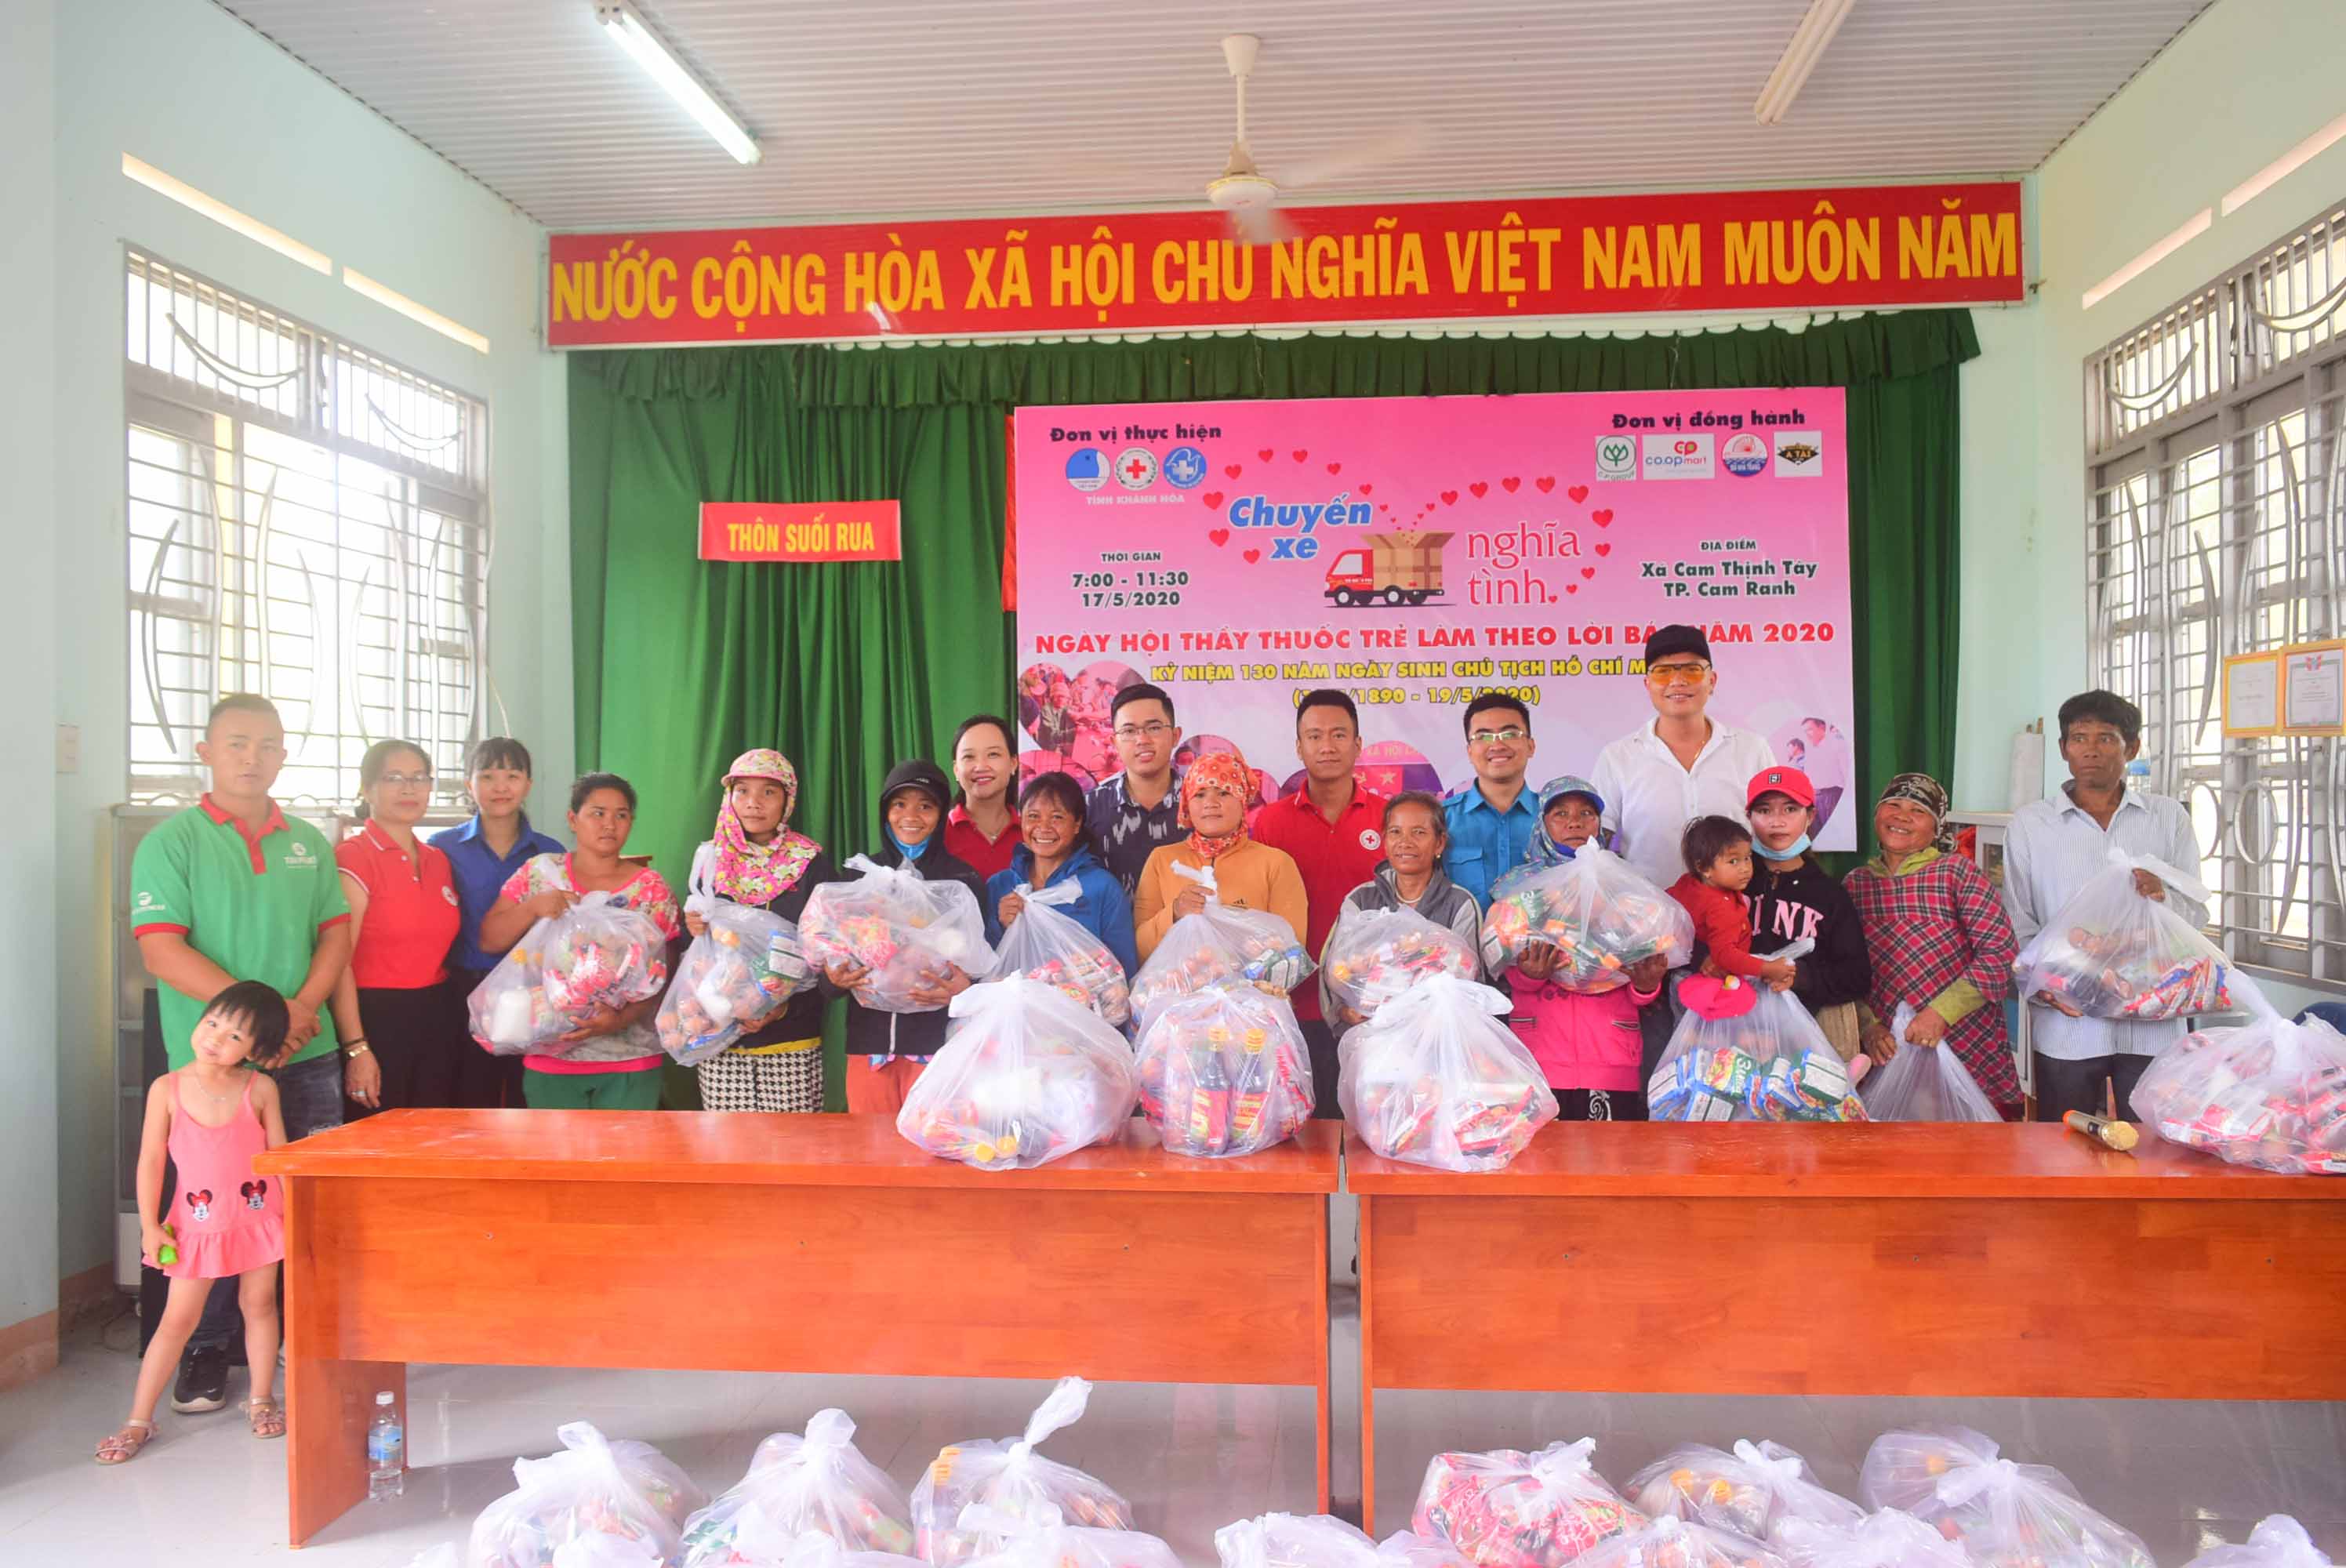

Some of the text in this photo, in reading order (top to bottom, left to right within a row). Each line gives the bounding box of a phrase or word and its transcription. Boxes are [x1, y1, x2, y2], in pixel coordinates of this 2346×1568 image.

[553, 241, 677, 321] NƯỚC
[692, 241, 826, 332] CỘNG
[845, 233, 944, 314] HÒA
[964, 230, 1032, 310] XÃ
[1051, 225, 1134, 321] HỘI
[1271, 217, 1429, 299] NGHĨA
[1444, 212, 1561, 307] VIỆT
[1583, 223, 1702, 291] NAM
[1724, 200, 1880, 288] MUÔN
[1898, 198, 2017, 282] NĂM
[1663, 413, 1681, 431] vị
[1099, 426, 1117, 444] vị
[1229, 493, 1372, 534] Chuyến
[728, 512, 875, 553] THÔN SUỐI RUA
[1133, 552, 1161, 561] GIAN
[1270, 537, 1318, 559] xe
[1468, 521, 1582, 570] nghĩa
[1072, 574, 1113, 587] 7:00
[1136, 572, 1189, 586] 11:30
[1674, 562, 1715, 576] Cam
[1722, 560, 1775, 579] Thịnh
[1468, 568, 1547, 605] tình
[1664, 580, 1796, 597] TP. Cam Ranh
[1082, 591, 1181, 608] 17/5/2020
[1036, 630, 1111, 653] NGÀY
[1121, 628, 1170, 657] HỘI
[1485, 626, 1557, 647] THEO
[1763, 622, 1835, 643] 2020
[1182, 661, 1235, 684] NIỆM
[1240, 664, 1277, 681] 130
[1396, 661, 1447, 678] SINH
[1499, 659, 1545, 681] TỊCH
[1588, 655, 1623, 675] CHÍ
